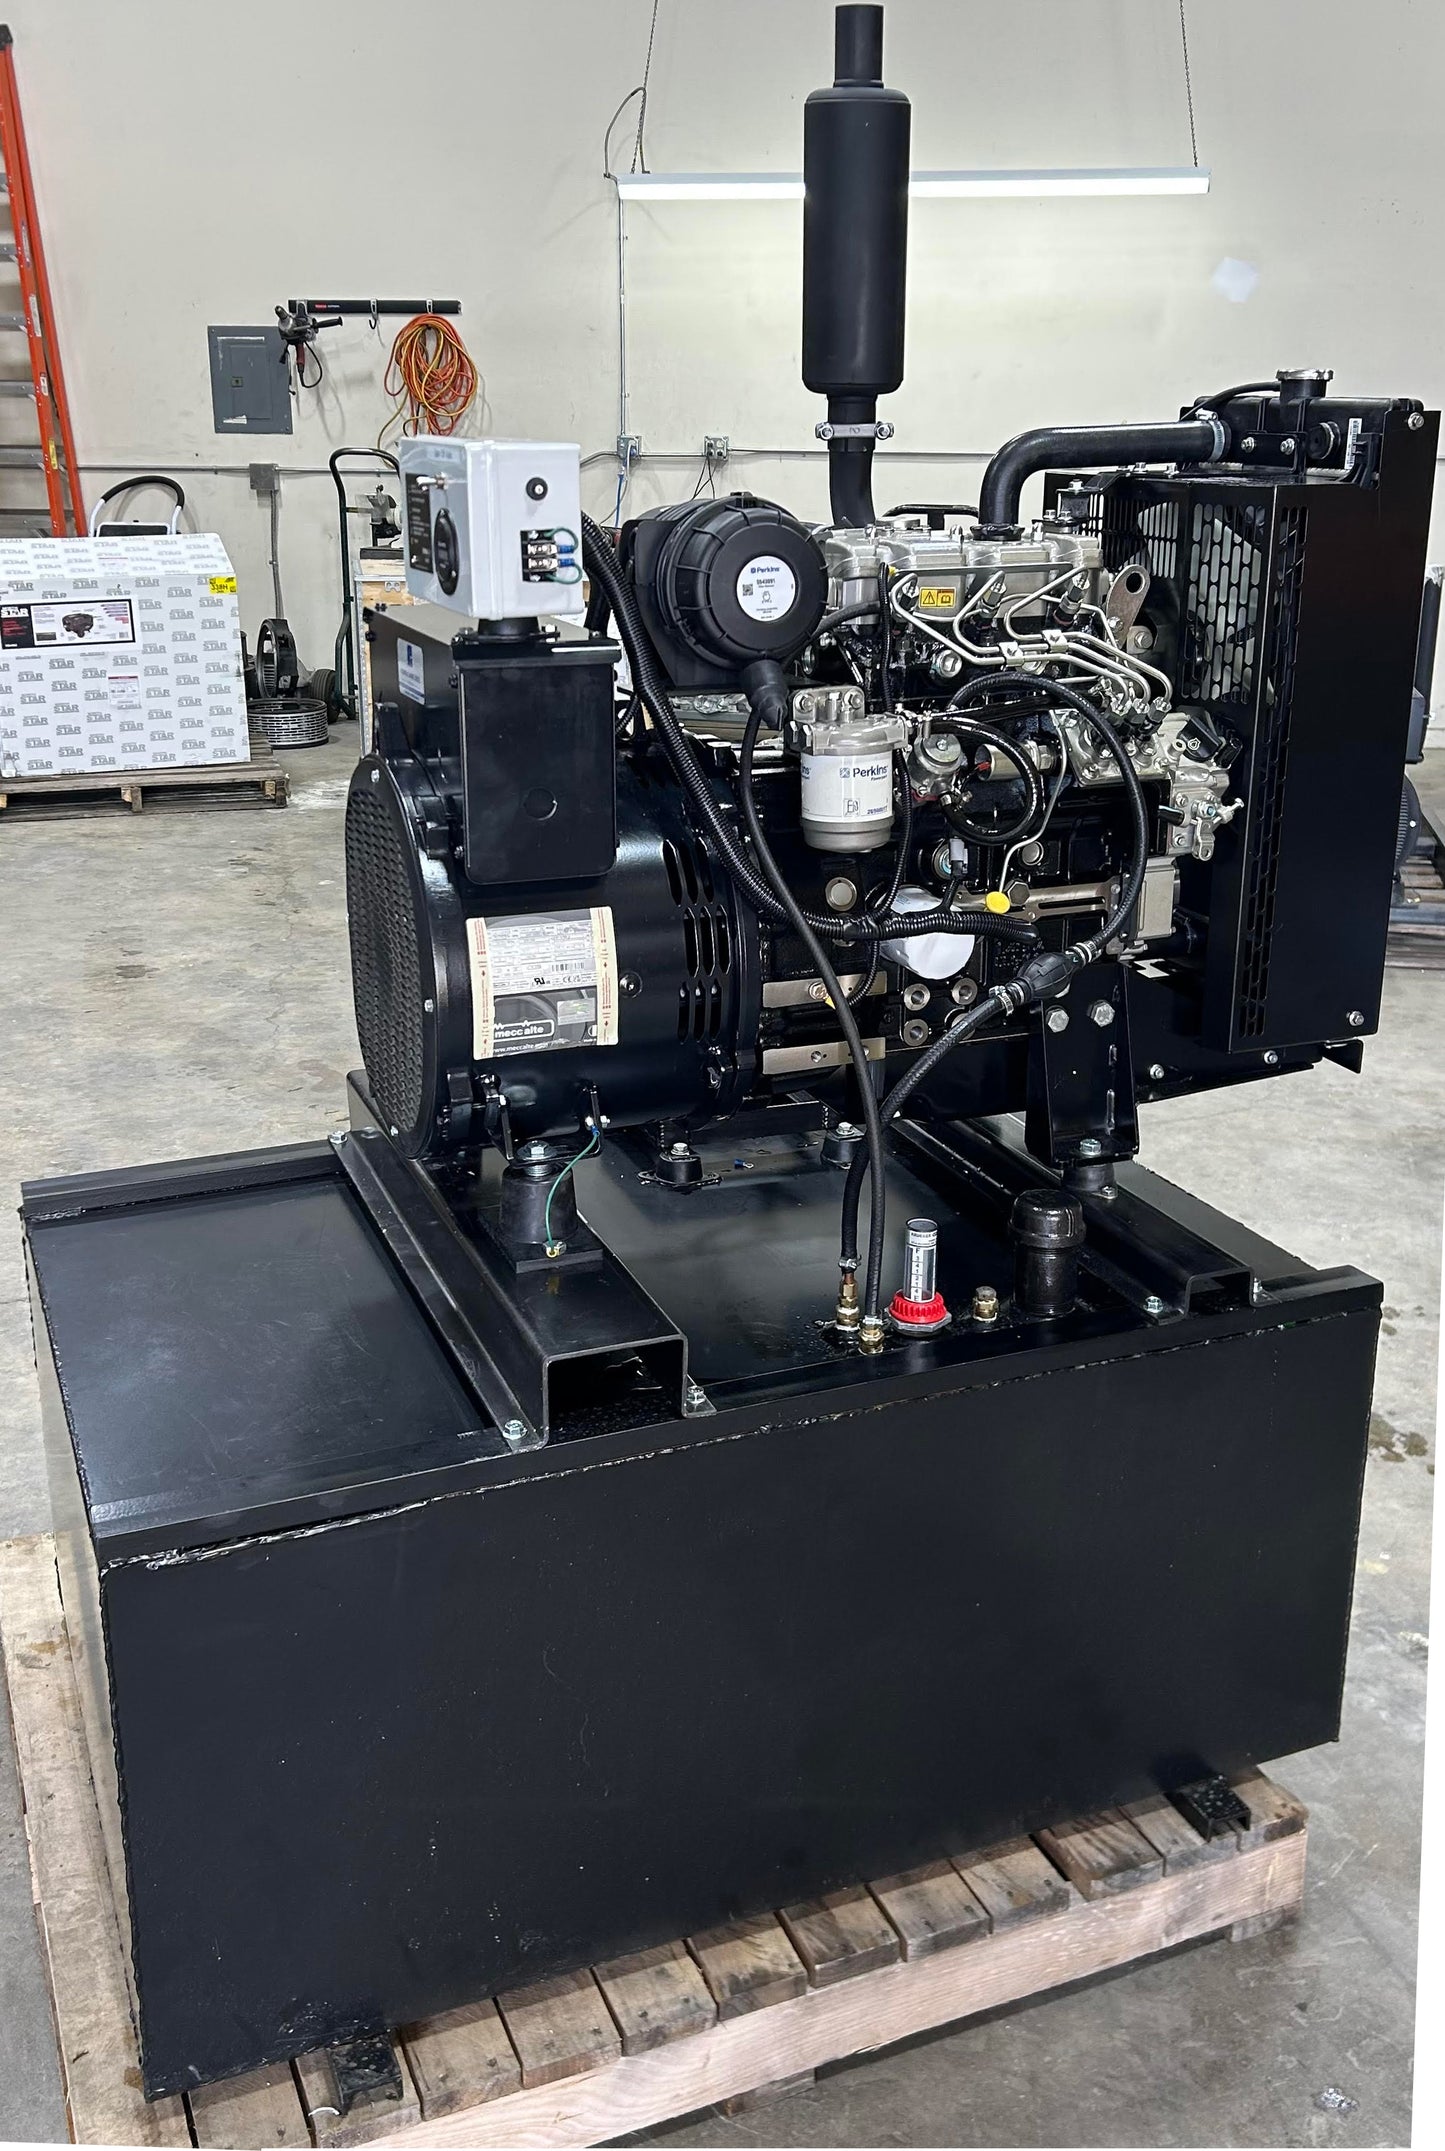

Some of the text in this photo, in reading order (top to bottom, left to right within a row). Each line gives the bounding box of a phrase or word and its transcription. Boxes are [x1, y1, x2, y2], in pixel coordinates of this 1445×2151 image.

[168, 589, 192, 598] STAR
[200, 599, 223, 607] STAR
[1, 608, 29, 618] STAR
[170, 611, 194, 620] STAR
[201, 621, 225, 629] STAR
[172, 633, 196, 641] STAR
[142, 645, 166, 654] STAR
[203, 642, 227, 651] STAR
[113, 658, 137, 666] STAR
[174, 655, 198, 663] STAR
[49, 660, 74, 669] STAR
[206, 664, 229, 673] STAR
[82, 670, 107, 679] STAR
[144, 668, 168, 676] STAR
[18, 673, 44, 682] STAR
[176, 677, 200, 685] STAR
[52, 682, 77, 691] STAR
[208, 686, 231, 695] STAR
[146, 689, 170, 698] STAR
[21, 695, 46, 704] STAR
[178, 698, 202, 707] STAR
[54, 704, 79, 713] STAR
[209, 707, 232, 716] STAR
[87, 714, 112, 723] STAR
[148, 711, 172, 720] STAR
[23, 718, 48, 726] STAR
[180, 720, 203, 728] STAR
[56, 726, 81, 735] STAR
[120, 723, 144, 731] STAR
[150, 733, 174, 741] STAR
[211, 729, 234, 737] STAR
[25, 740, 50, 748] STAR
[89, 736, 114, 744] STAR
[121, 744, 146, 753] STAR
[182, 741, 205, 750] STAR
[58, 748, 83, 757] STAR
[212, 750, 236, 758] STAR
[91, 757, 116, 766] STAR
[152, 754, 176, 762] STAR
[28, 762, 53, 770] STAR
[853, 765, 888, 777] Perkins
